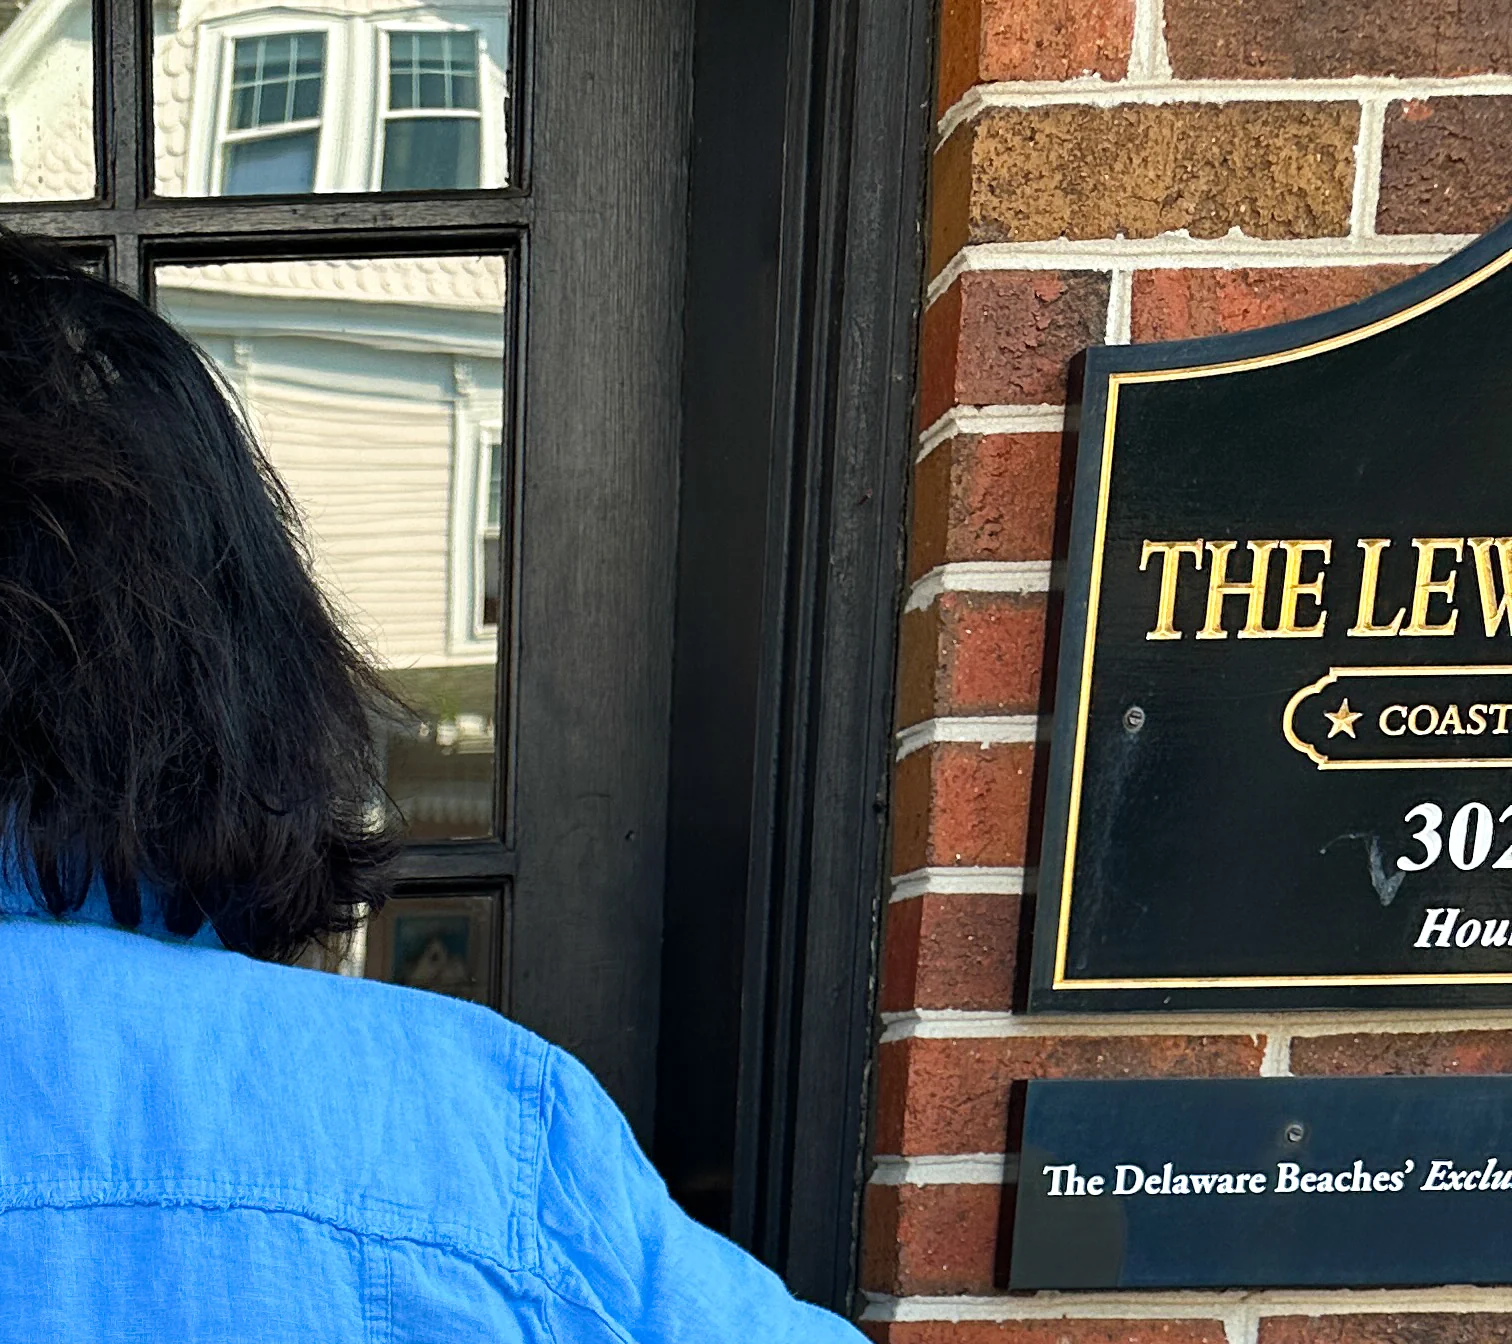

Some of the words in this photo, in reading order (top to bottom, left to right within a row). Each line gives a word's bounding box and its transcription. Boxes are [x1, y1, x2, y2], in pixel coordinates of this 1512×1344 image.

[1139, 537, 1332, 641] THE
[1379, 704, 1512, 736] COAST
[1413, 907, 1512, 948] Hou
[1042, 1163, 1105, 1196] The
[1112, 1161, 1267, 1195] Delaware
[1420, 1157, 1512, 1191] Exclu
